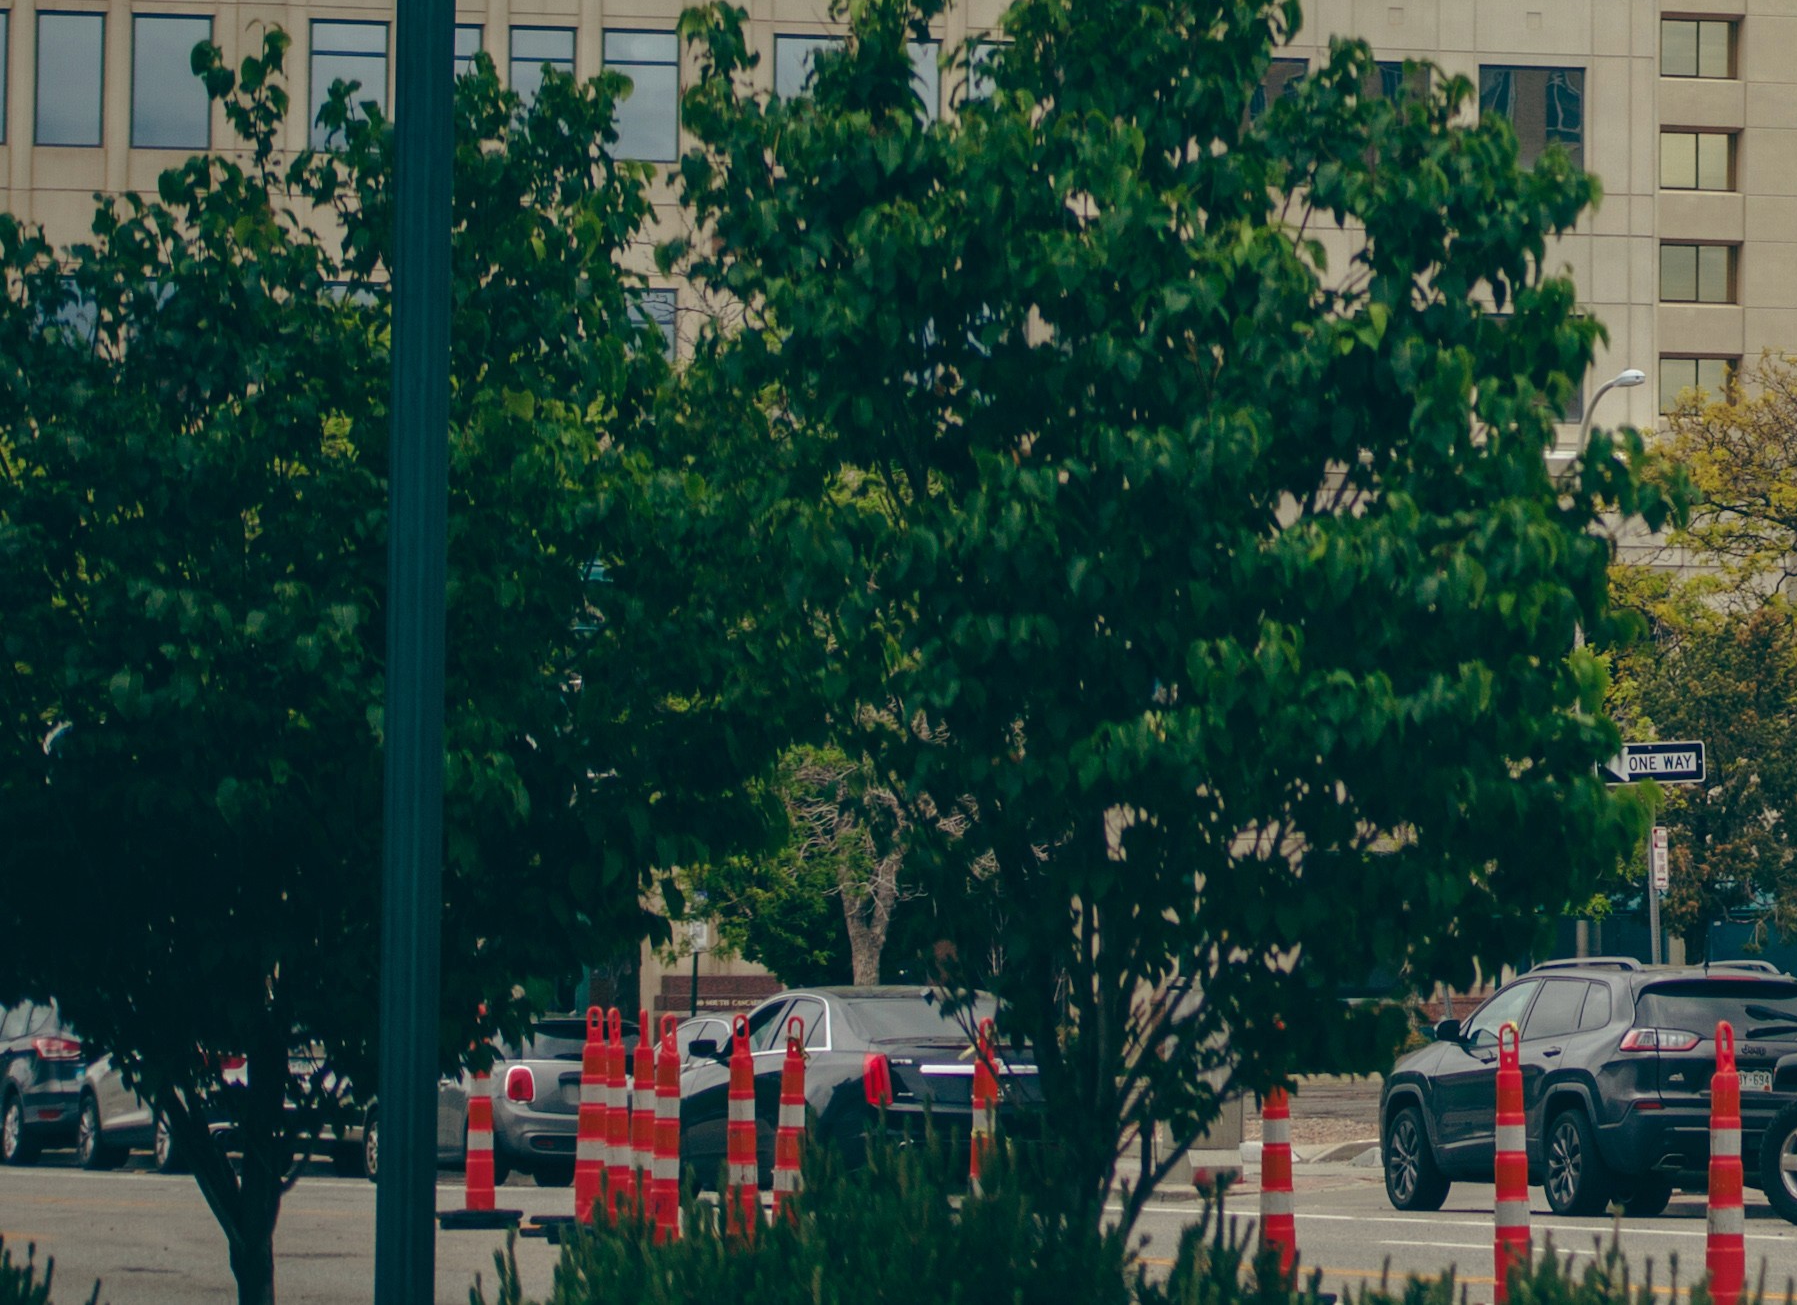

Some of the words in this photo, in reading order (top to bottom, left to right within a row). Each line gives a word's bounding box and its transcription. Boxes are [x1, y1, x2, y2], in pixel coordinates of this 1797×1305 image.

[1629, 756, 1657, 772] ONE
[1663, 754, 1692, 771] WAY
[1741, 1044, 1767, 1056] Jeep
